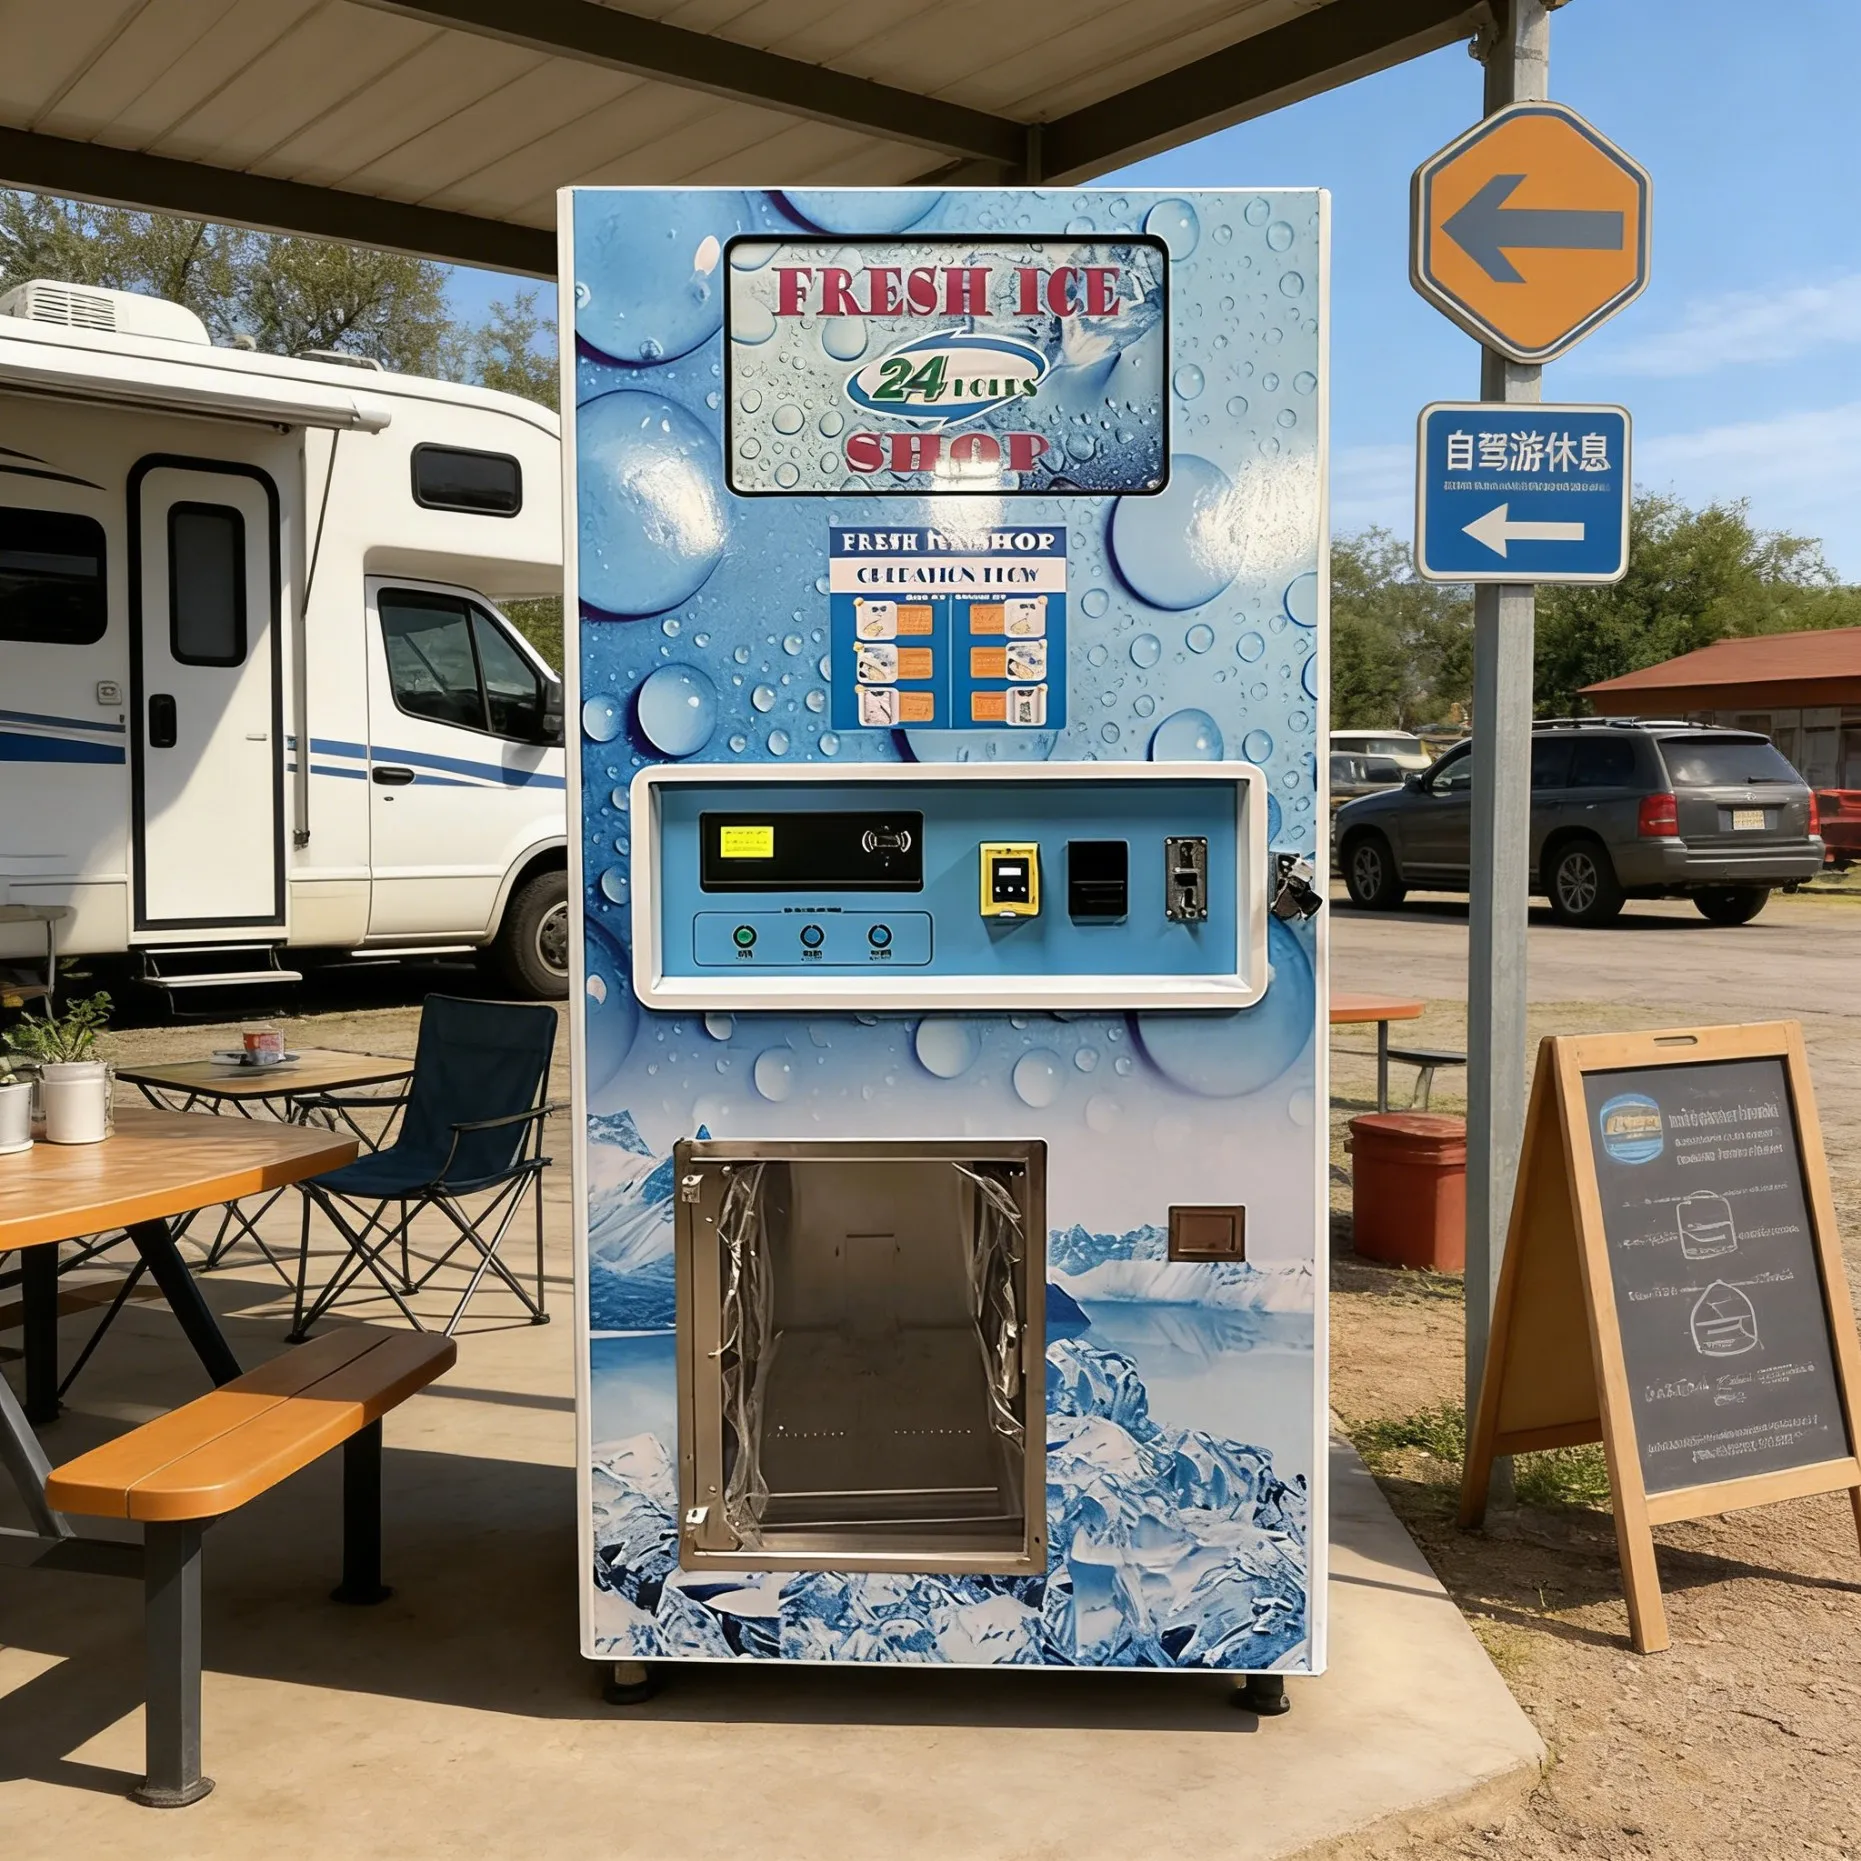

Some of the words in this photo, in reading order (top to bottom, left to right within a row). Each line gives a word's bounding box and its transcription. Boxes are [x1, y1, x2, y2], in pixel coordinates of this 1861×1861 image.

[772, 266, 992, 317] FRESH
[1014, 266, 1121, 317] ICE
[872, 355, 948, 401] 24
[846, 432, 1050, 474] SHOP
[1447, 430, 1611, 472] 自驾游休息
